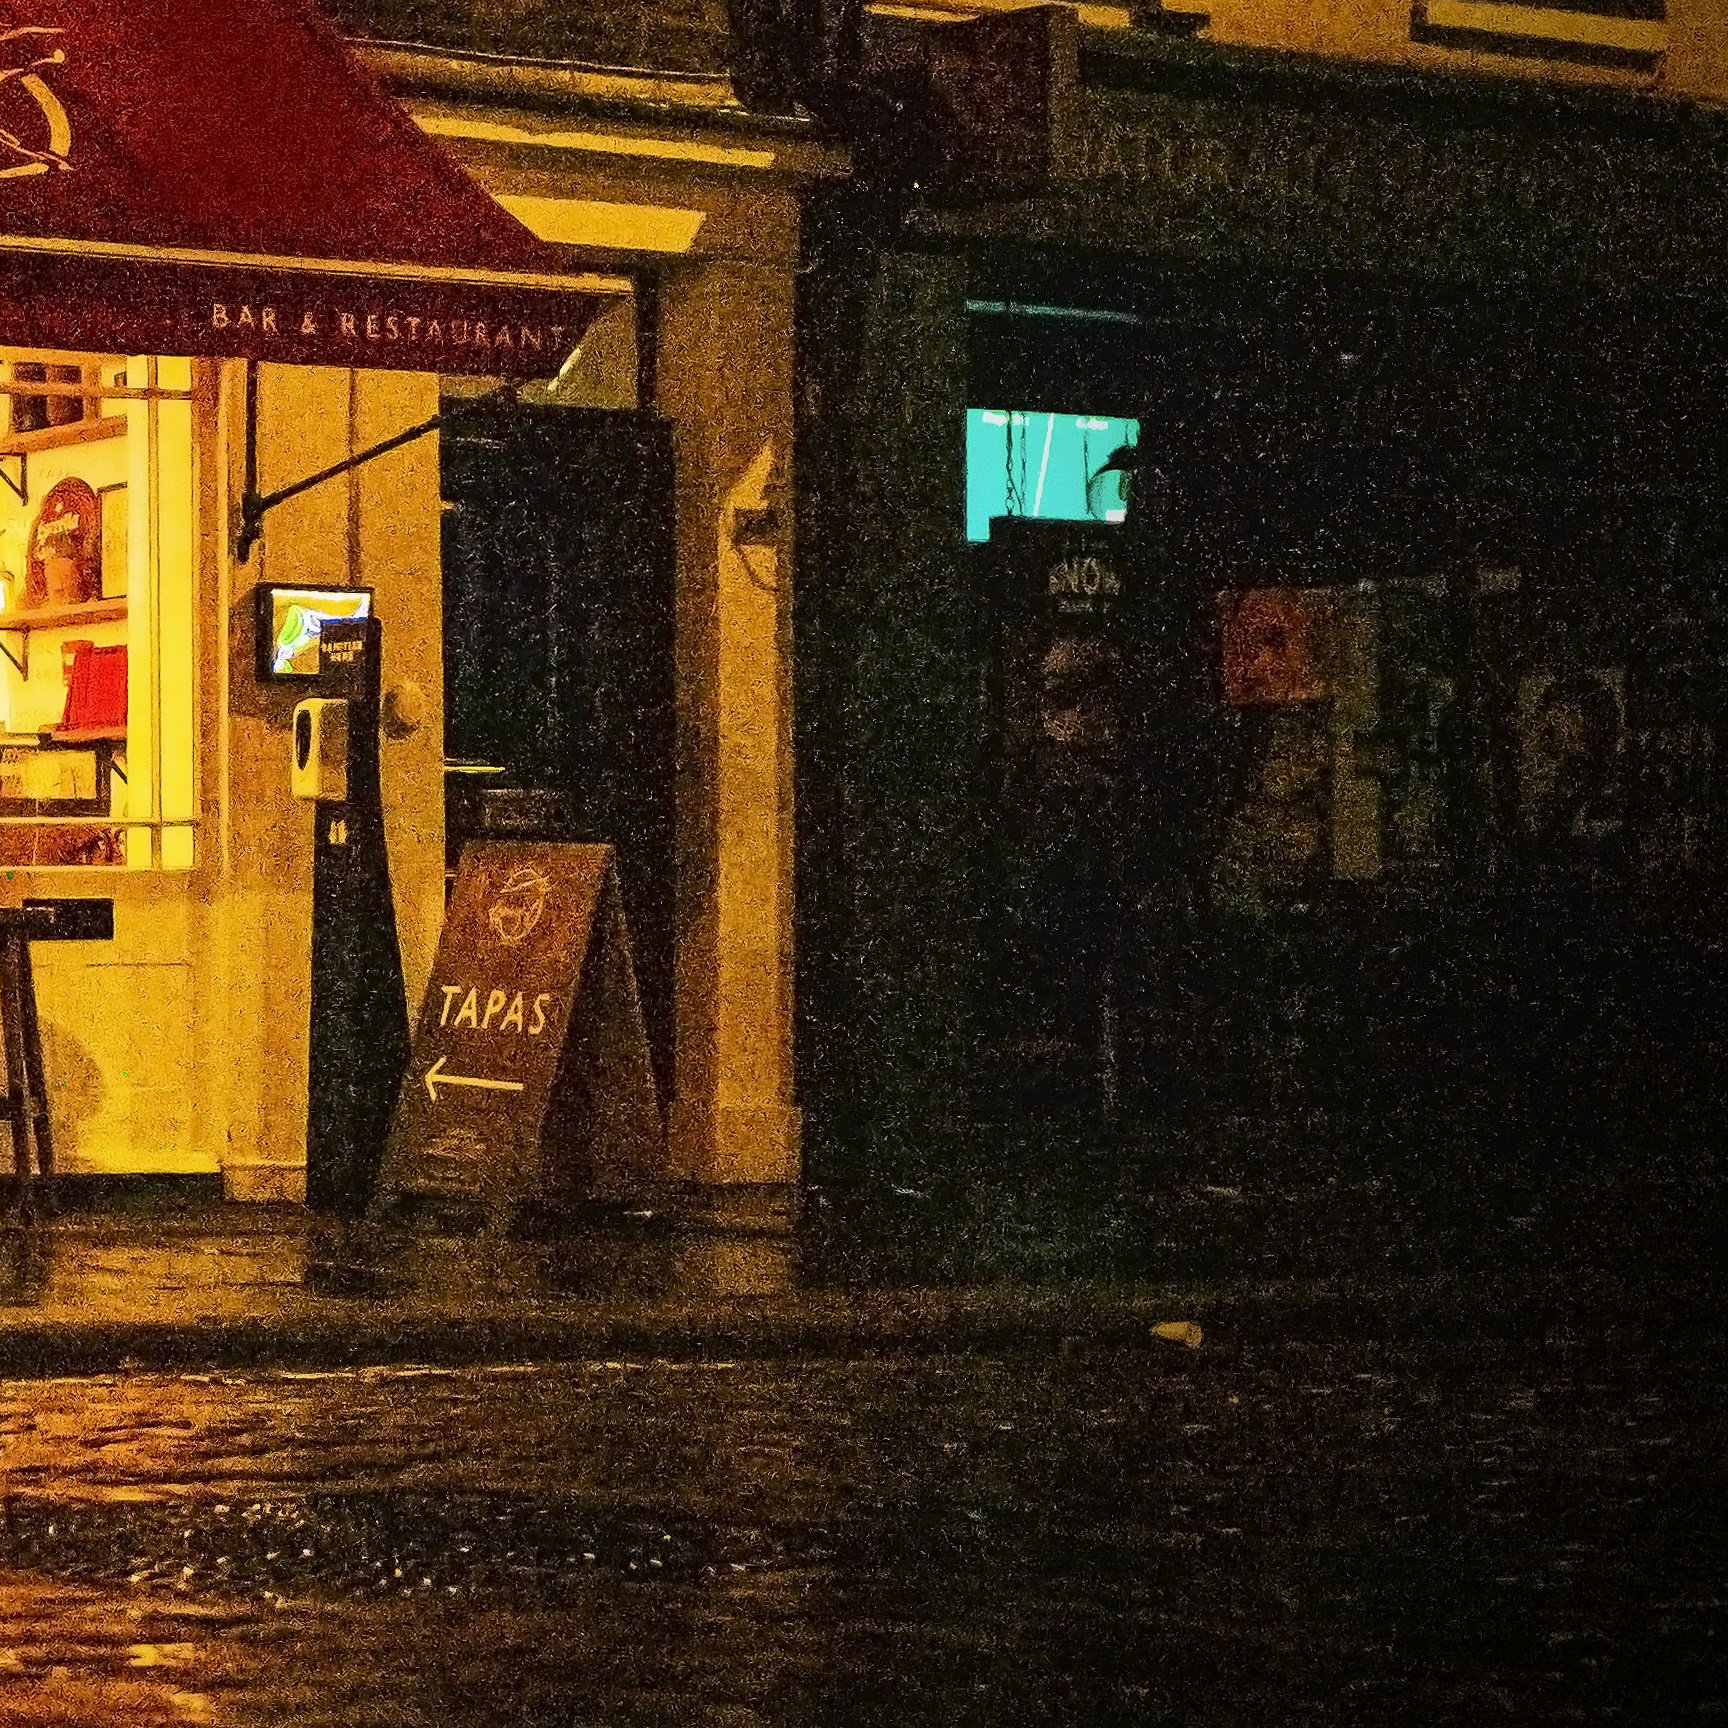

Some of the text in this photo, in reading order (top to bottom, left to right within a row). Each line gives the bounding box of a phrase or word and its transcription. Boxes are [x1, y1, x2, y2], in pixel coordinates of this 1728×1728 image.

[211, 303, 573, 349] BAR & RESTAURANT
[439, 985, 550, 1035] TAPAS
